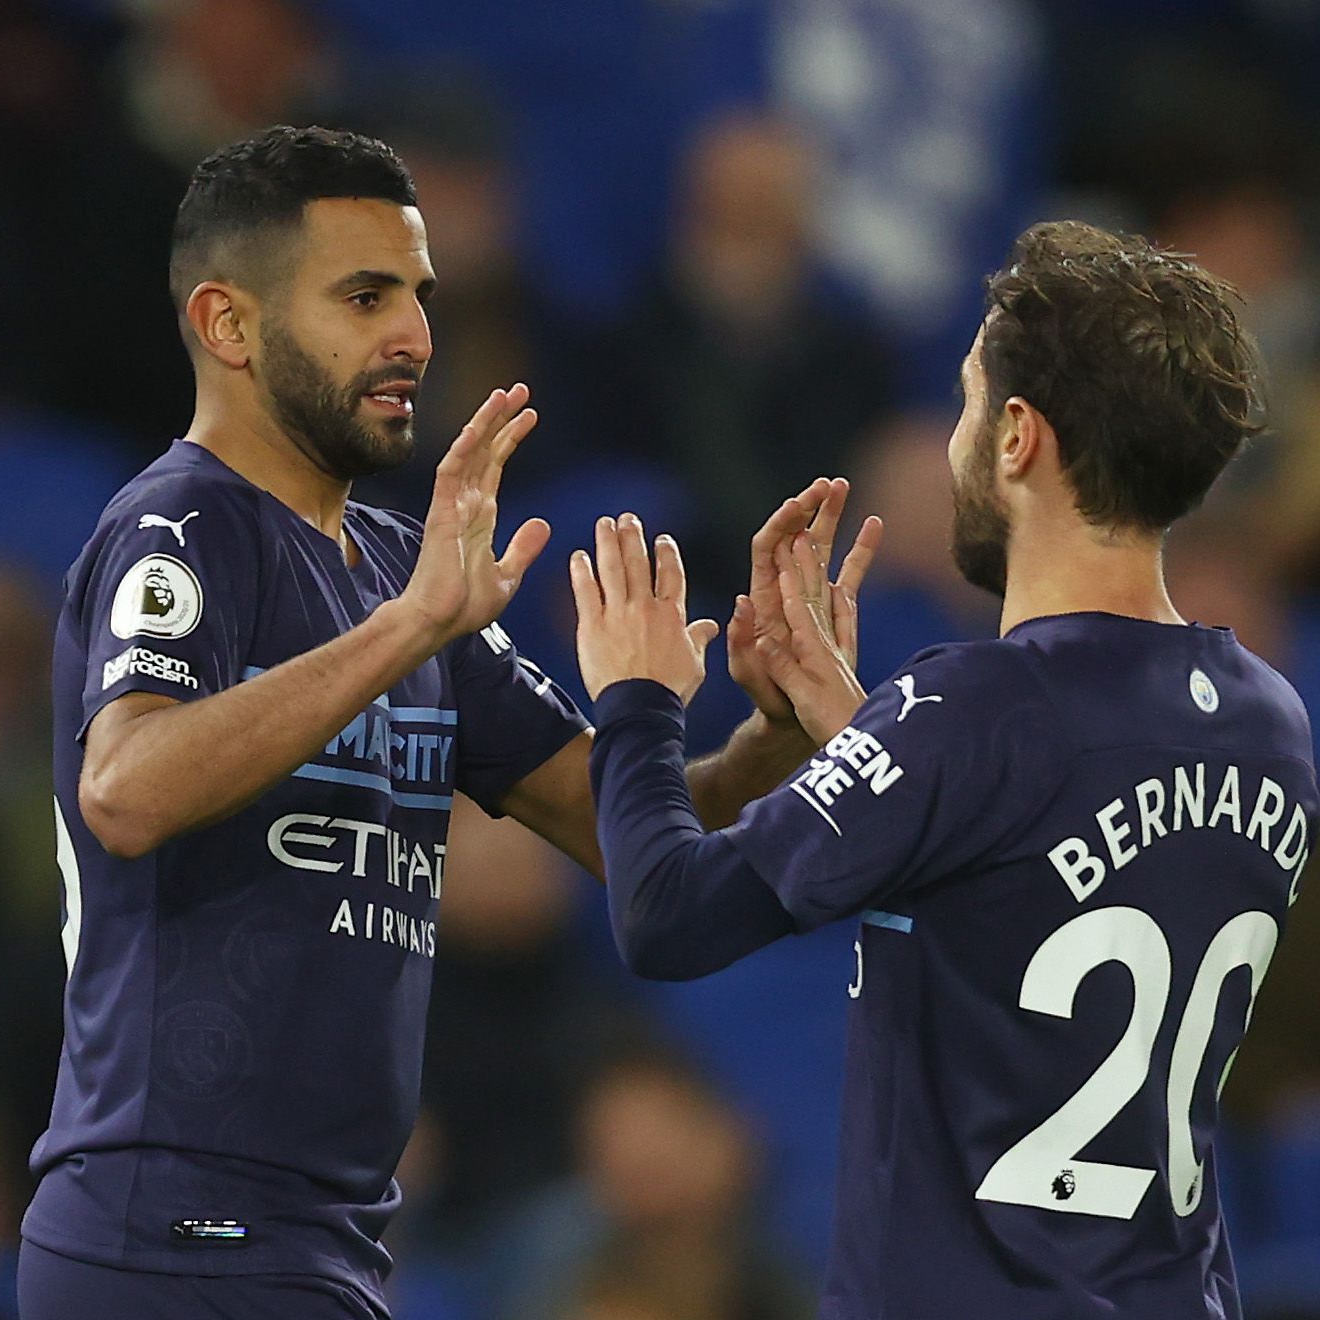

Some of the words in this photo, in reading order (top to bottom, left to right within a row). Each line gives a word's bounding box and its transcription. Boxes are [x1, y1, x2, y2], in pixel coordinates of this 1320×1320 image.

[129, 660, 198, 690] racism
[131, 647, 189, 674] room
[1047, 761, 1309, 908] BERNARD
[329, 898, 436, 959] AIRWAYS
[975, 905, 1279, 1217] 20
